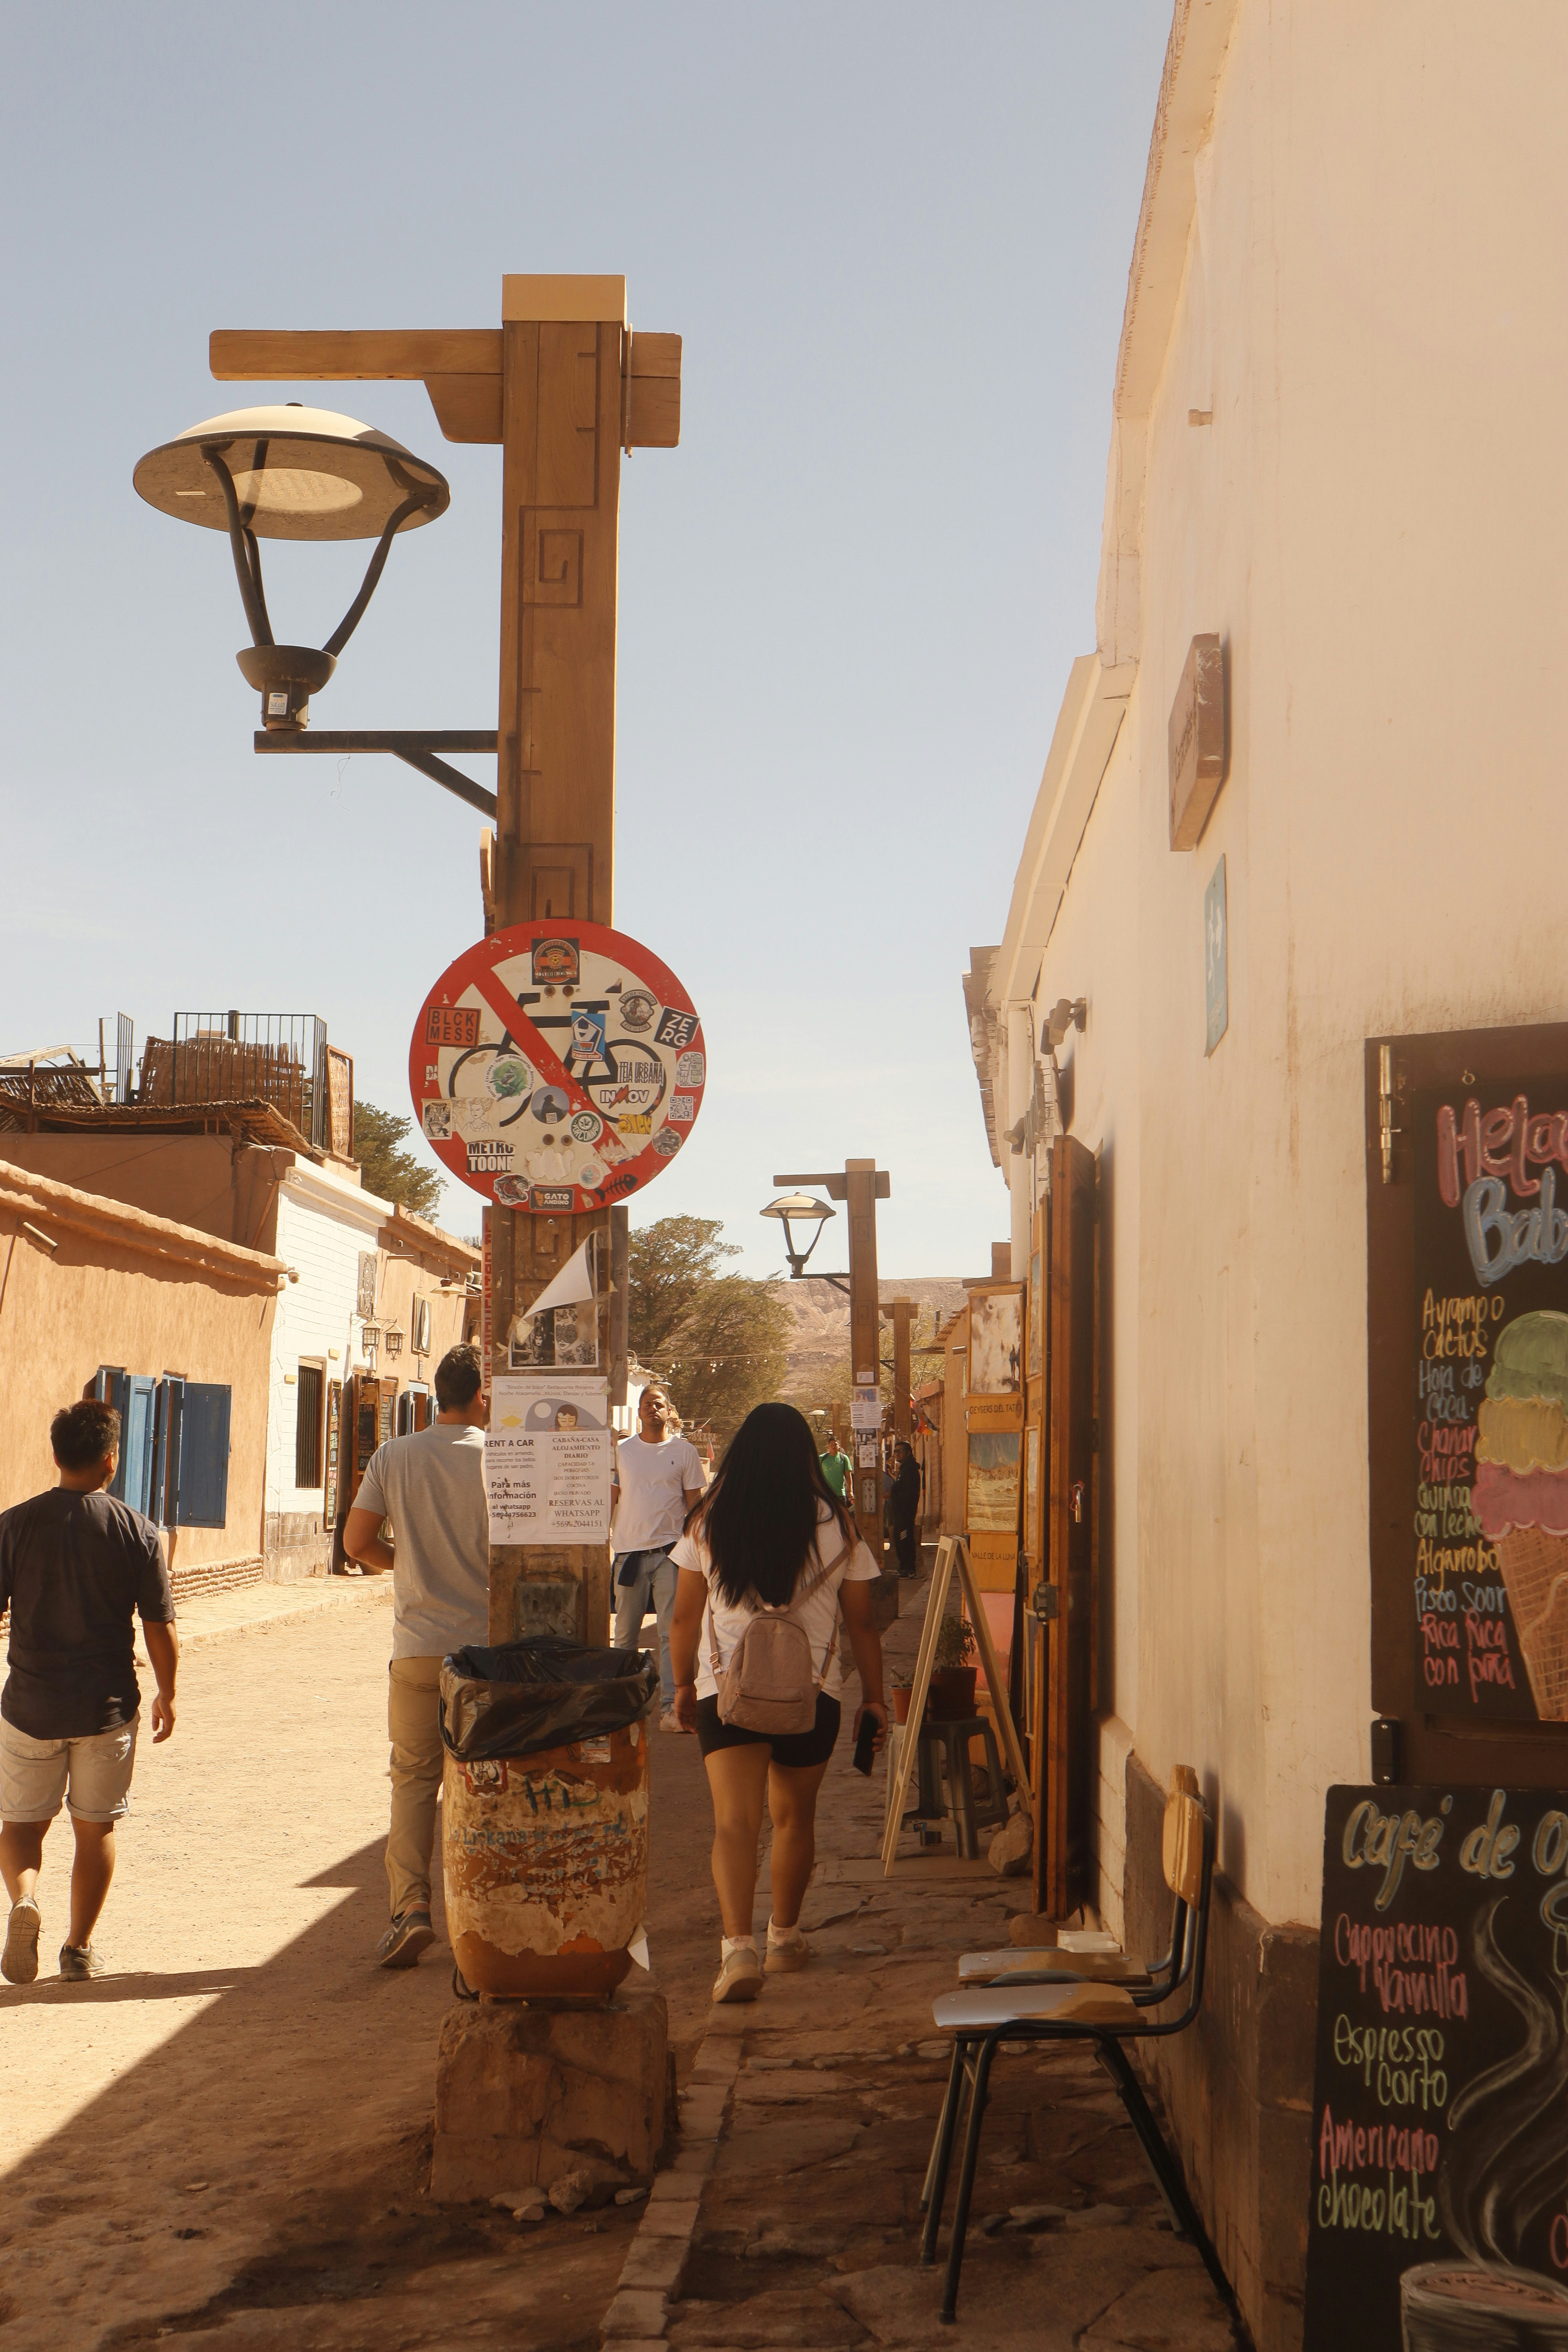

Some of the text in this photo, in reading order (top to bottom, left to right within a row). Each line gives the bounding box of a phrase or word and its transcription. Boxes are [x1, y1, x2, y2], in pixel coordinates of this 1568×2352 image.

[432, 1011, 474, 1027] BLCK
[666, 1014, 693, 1032] ZE
[430, 1026, 474, 1042] MESS
[660, 1028, 688, 1045] RG
[635, 1062, 664, 1084] URBANA
[468, 1142, 514, 1154] METRO
[1461, 1355, 1483, 1389] de
[969, 1405, 993, 1414] GEYSERS
[994, 1404, 1005, 1412] DEL
[487, 1491, 536, 1499] información
[1443, 1507, 1485, 1538] leche
[1416, 1537, 1501, 1595] Algarrobo
[1419, 1606, 1508, 1655] Rica Rica
[1423, 1653, 1516, 1704] con piña
[1343, 1795, 1453, 1912] Café
[1459, 1789, 1521, 1879] de
[1320, 2103, 1439, 2180] Americano
